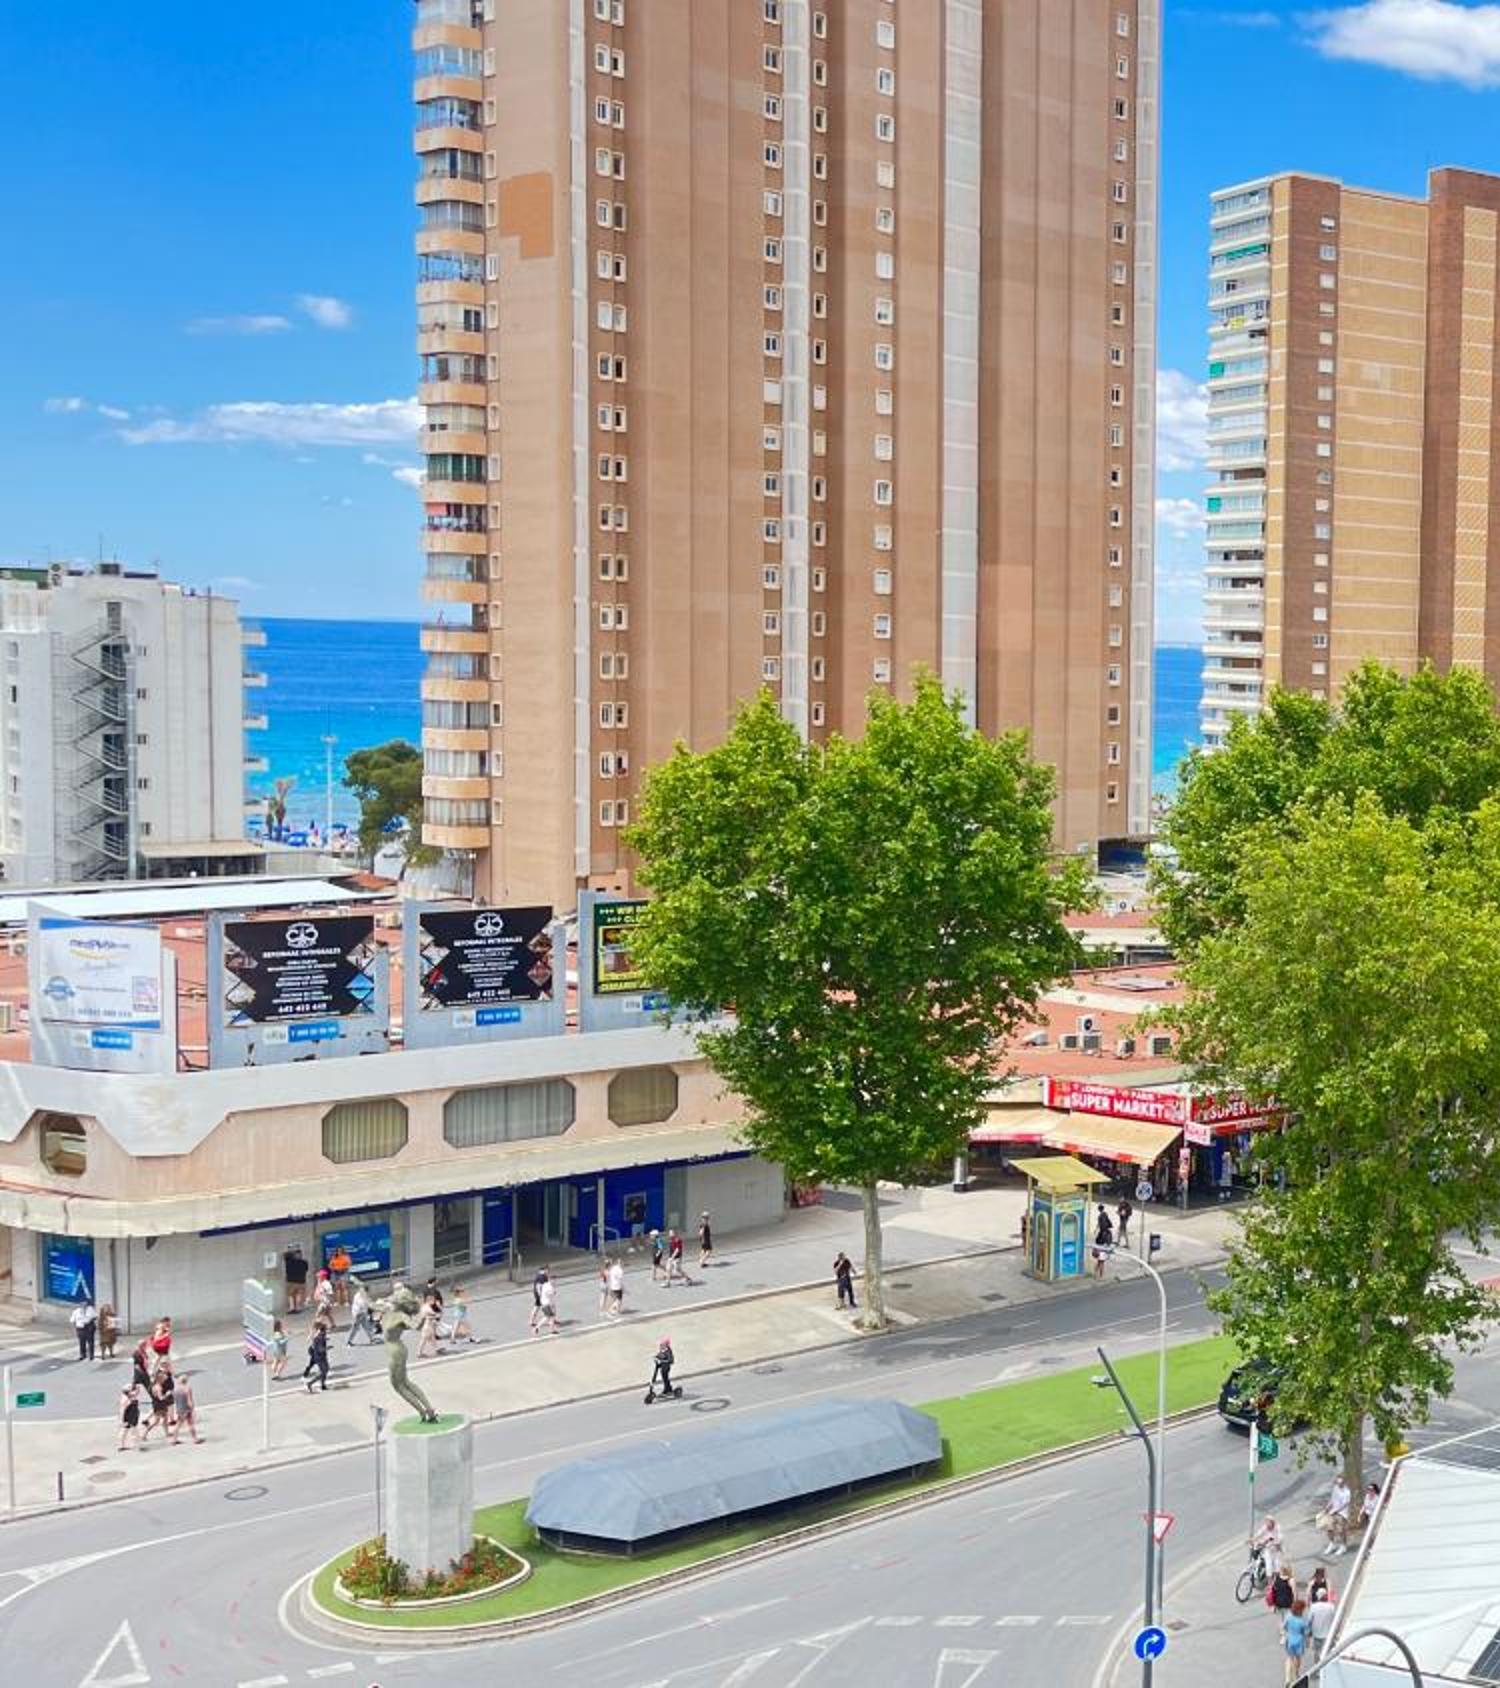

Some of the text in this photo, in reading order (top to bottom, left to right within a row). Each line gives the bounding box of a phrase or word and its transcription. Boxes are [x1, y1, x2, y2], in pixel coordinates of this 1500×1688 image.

[1071, 1091, 1164, 1120] SUPER MARKET
[1209, 1101, 1247, 1119] SUPER
